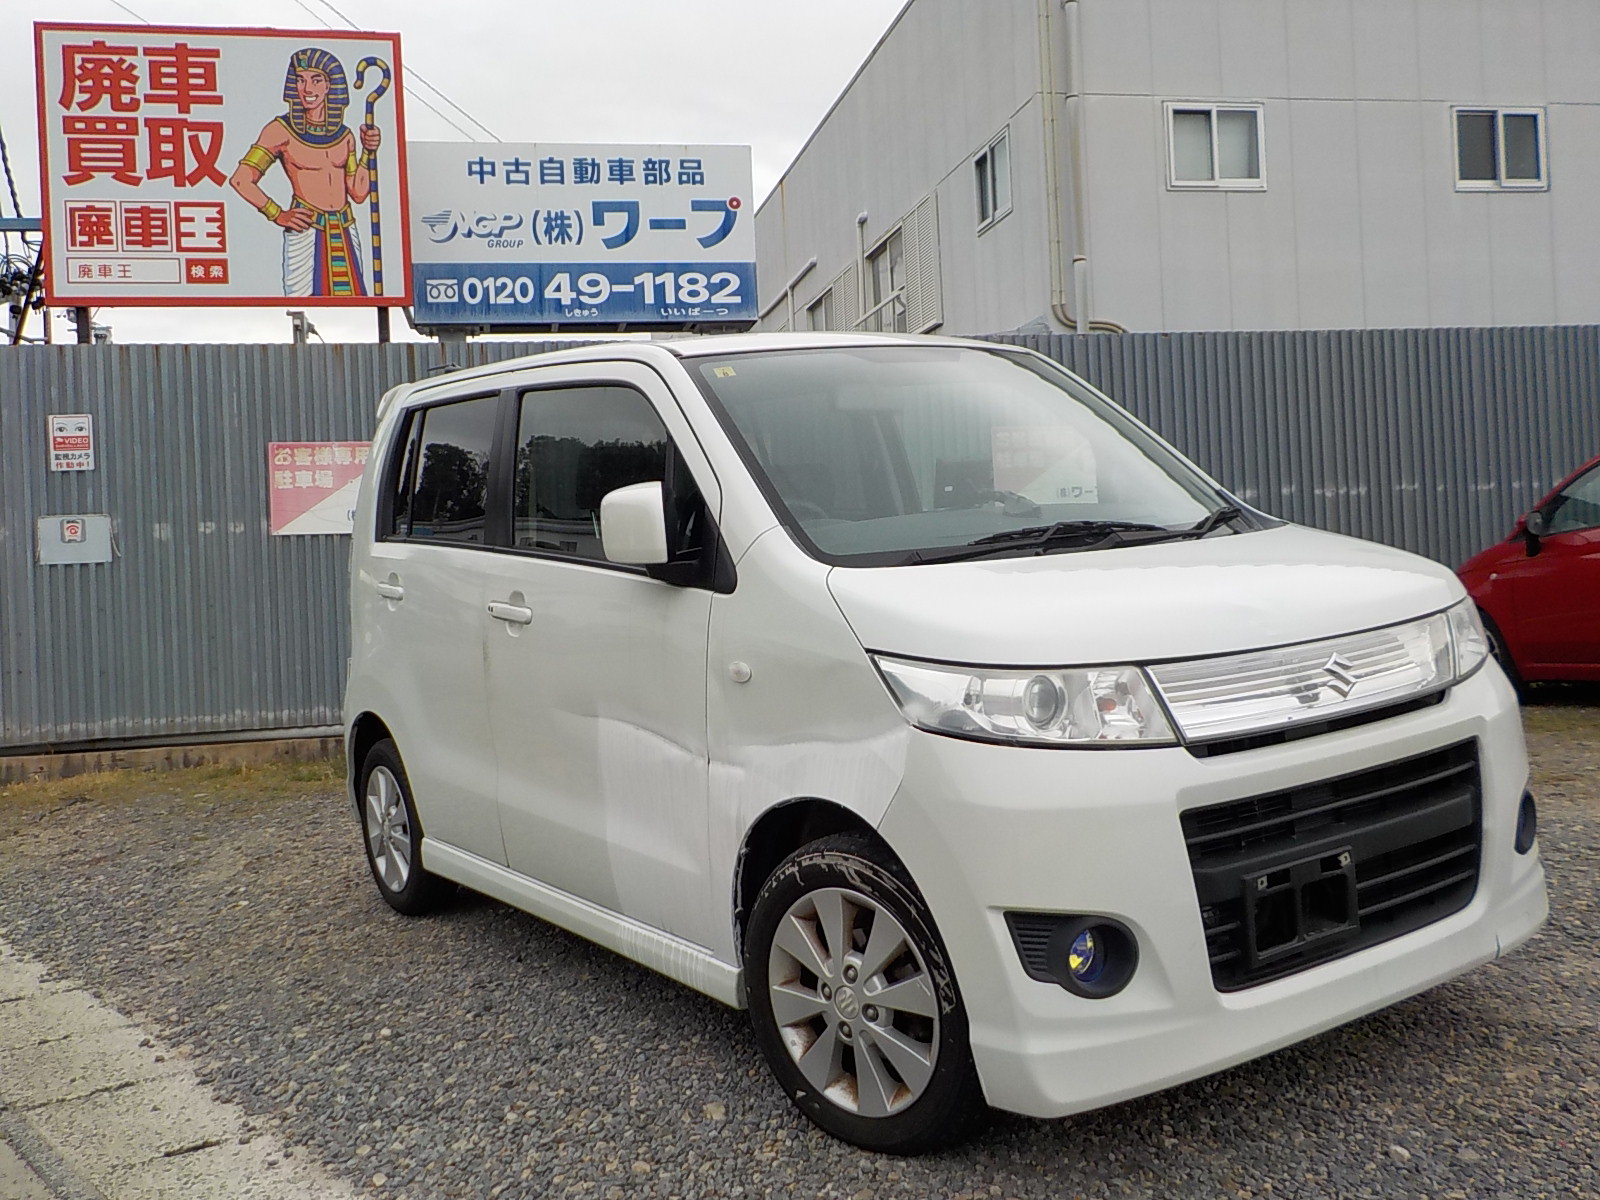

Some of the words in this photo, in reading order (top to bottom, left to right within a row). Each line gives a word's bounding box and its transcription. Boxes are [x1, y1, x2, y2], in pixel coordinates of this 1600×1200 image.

[58, 40, 224, 114] 廃車
[62, 115, 228, 188] 買取
[467, 156, 705, 186] 中古自動車部品
[487, 239, 524, 249] GROUP
[78, 263, 132, 279] 廃車王
[190, 264, 224, 279] 検索
[462, 276, 535, 305] 0120
[543, 272, 742, 306] 49-1182
